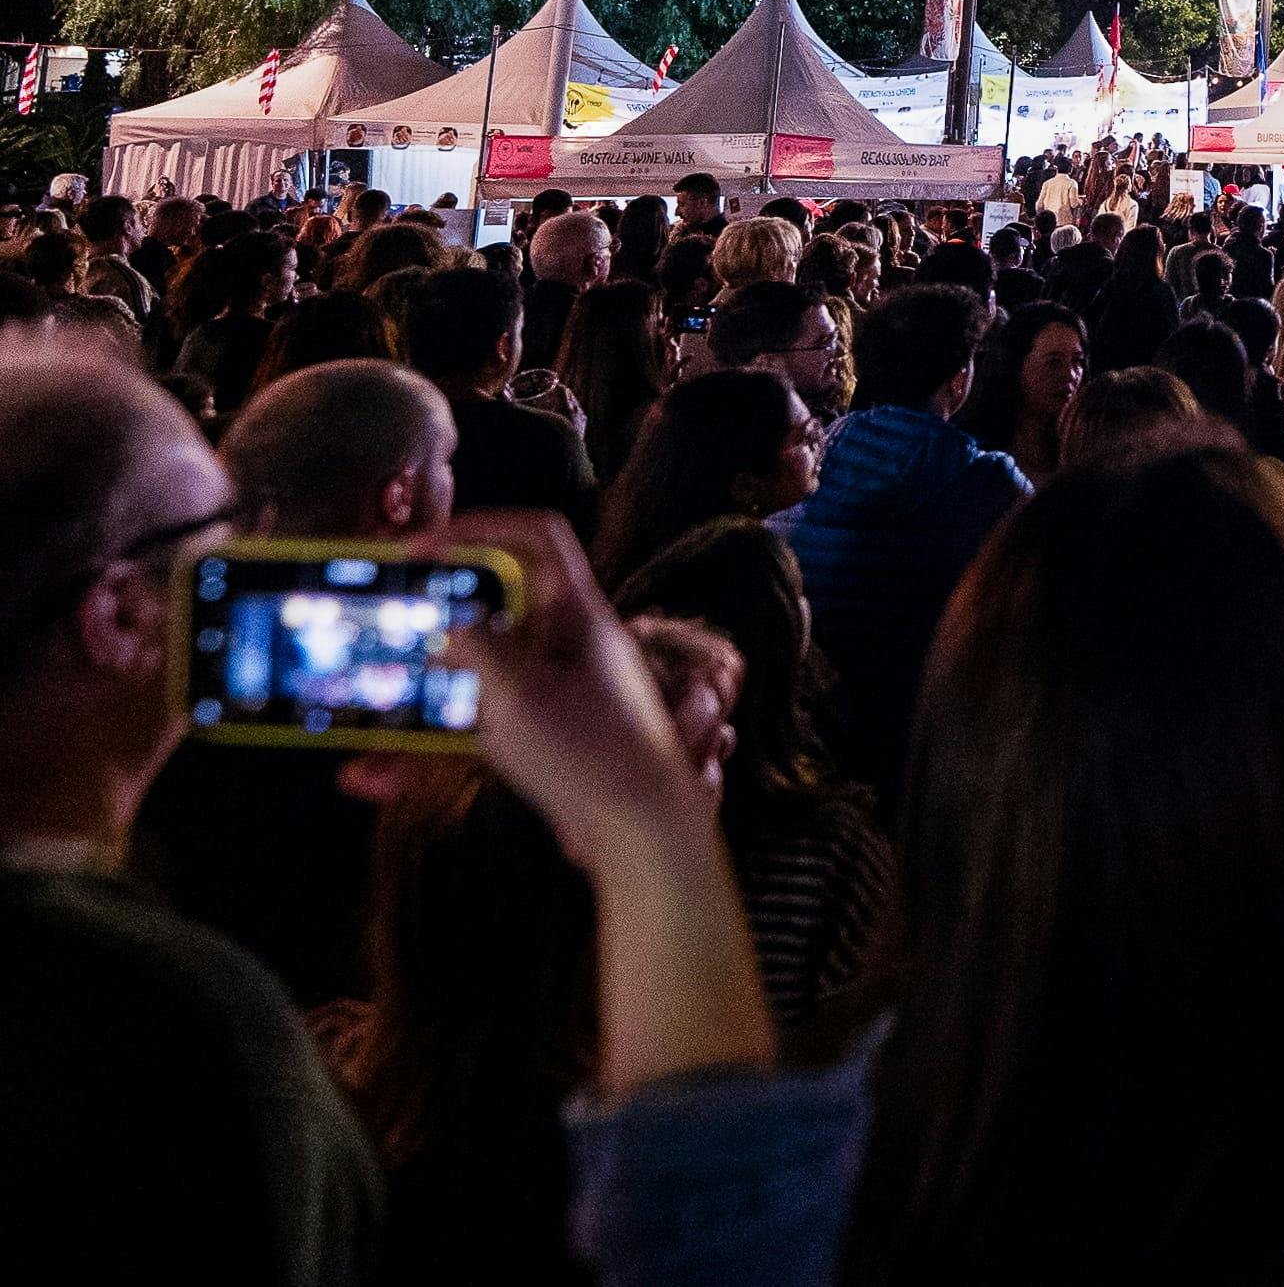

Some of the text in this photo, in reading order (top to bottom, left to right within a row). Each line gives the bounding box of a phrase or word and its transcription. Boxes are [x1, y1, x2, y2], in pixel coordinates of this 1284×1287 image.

[580, 150, 696, 165] BASTILLE WINE WALK
[860, 150, 951, 168] BEAUJOLAIS BAR
